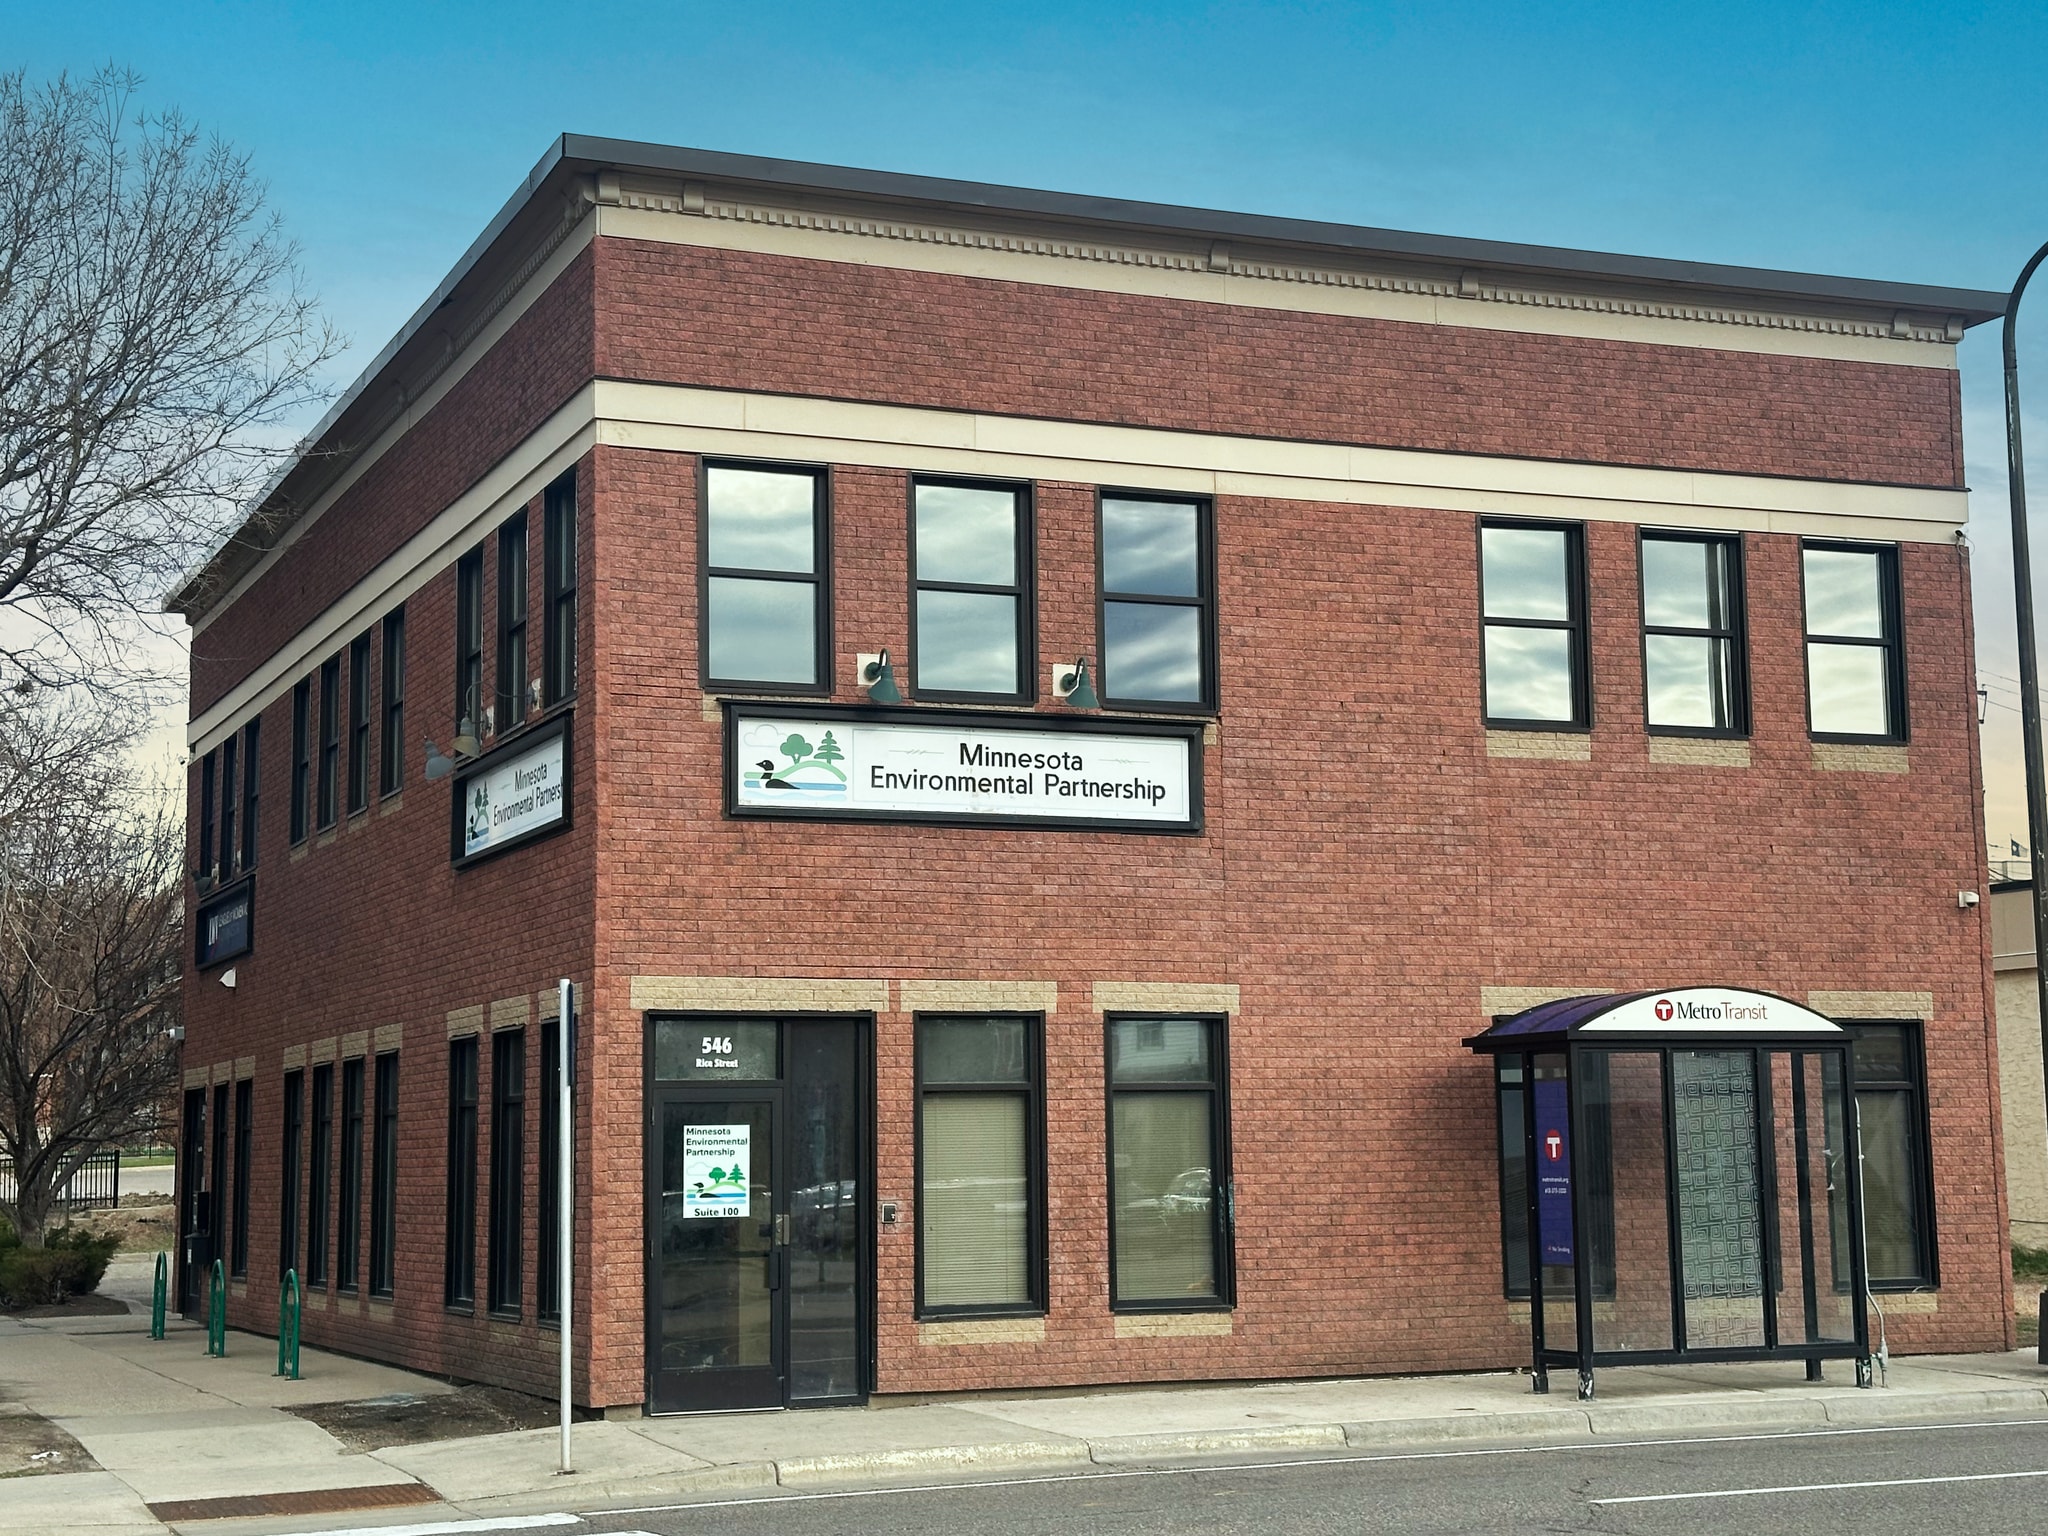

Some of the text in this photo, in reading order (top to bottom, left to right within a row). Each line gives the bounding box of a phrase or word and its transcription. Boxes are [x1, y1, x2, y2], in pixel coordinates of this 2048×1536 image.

[959, 743, 1083, 772] Minnesota
[514, 763, 548, 792] Minnesota
[870, 765, 1167, 806] Environmental Partnership
[493, 779, 563, 826] Environmental Partners
[701, 1036, 733, 1054] 546
[695, 1058, 739, 1068] Rice Street
[686, 1127, 731, 1136] Minnesota
[686, 1137, 748, 1146] Environmental
[686, 1148, 736, 1157] Partnership
[694, 1207, 739, 1217] Suite 100
